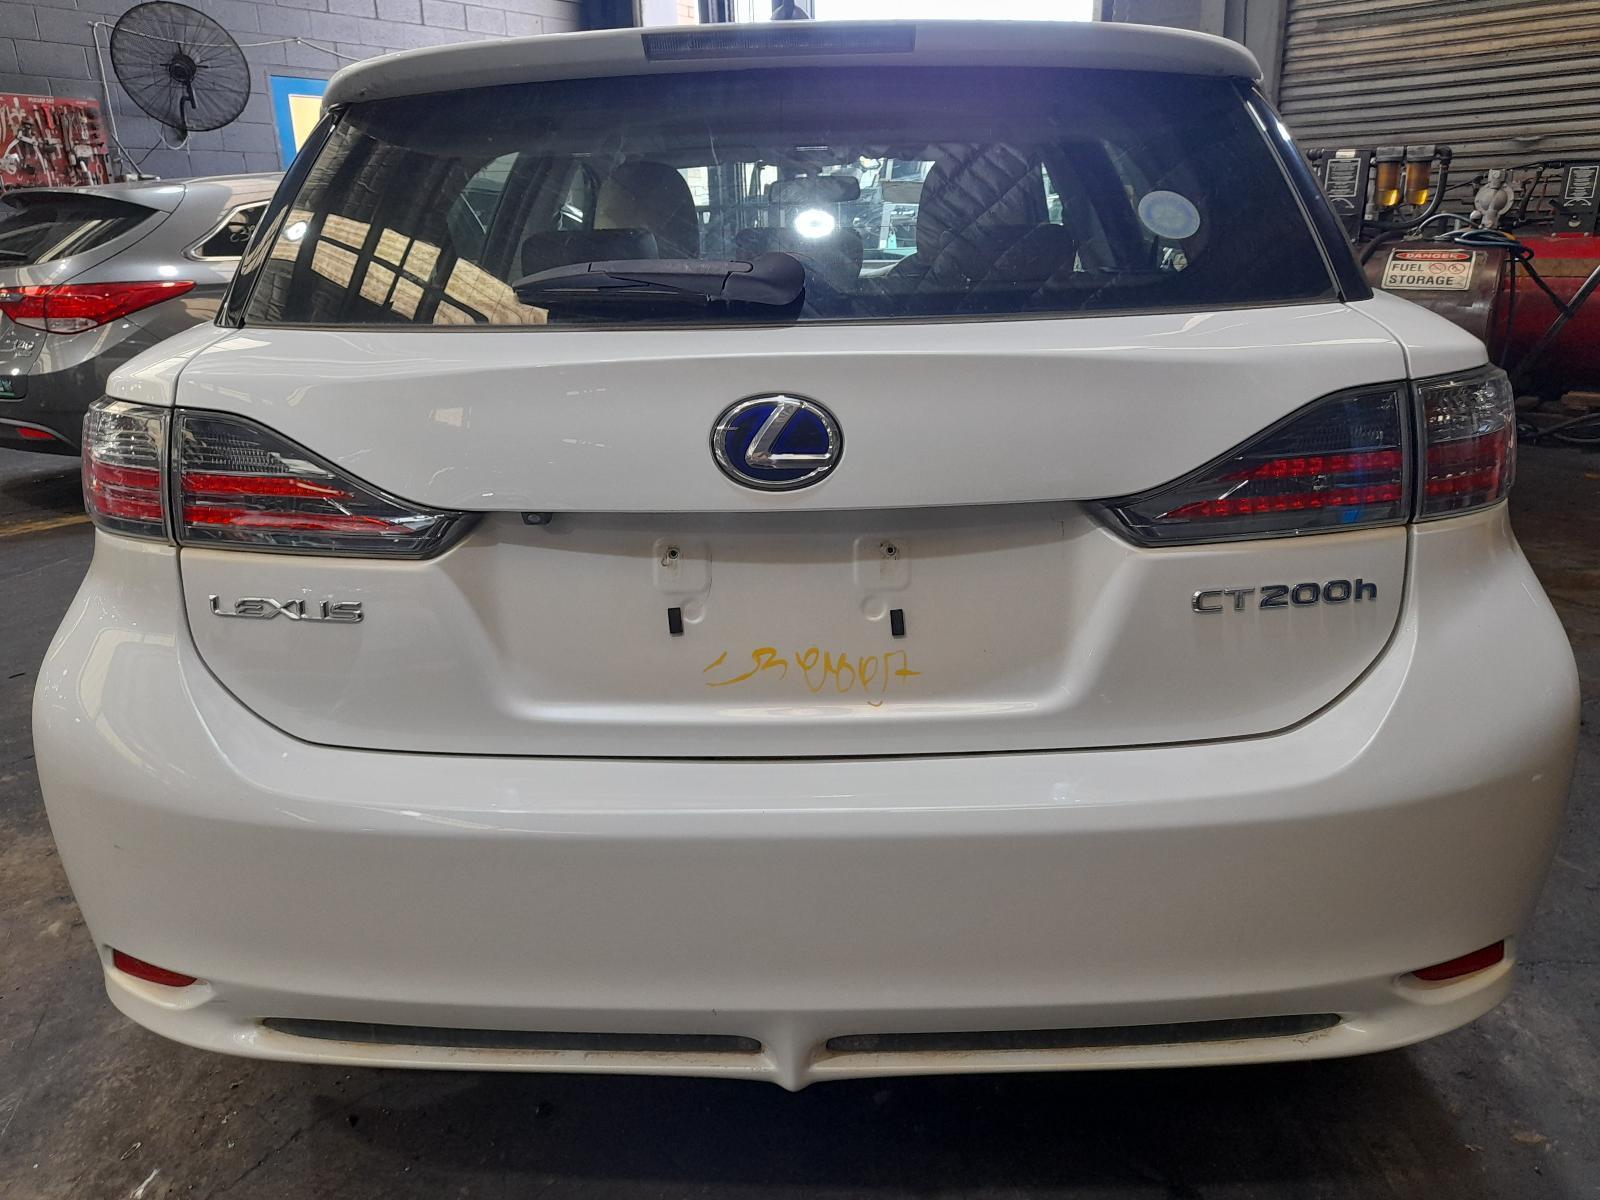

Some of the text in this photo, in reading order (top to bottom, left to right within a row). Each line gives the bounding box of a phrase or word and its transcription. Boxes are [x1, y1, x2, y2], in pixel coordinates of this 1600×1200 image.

[1392, 263, 1424, 272] FUEL
[1389, 274, 1454, 286] STORAGE
[208, 594, 364, 623] LEXUS
